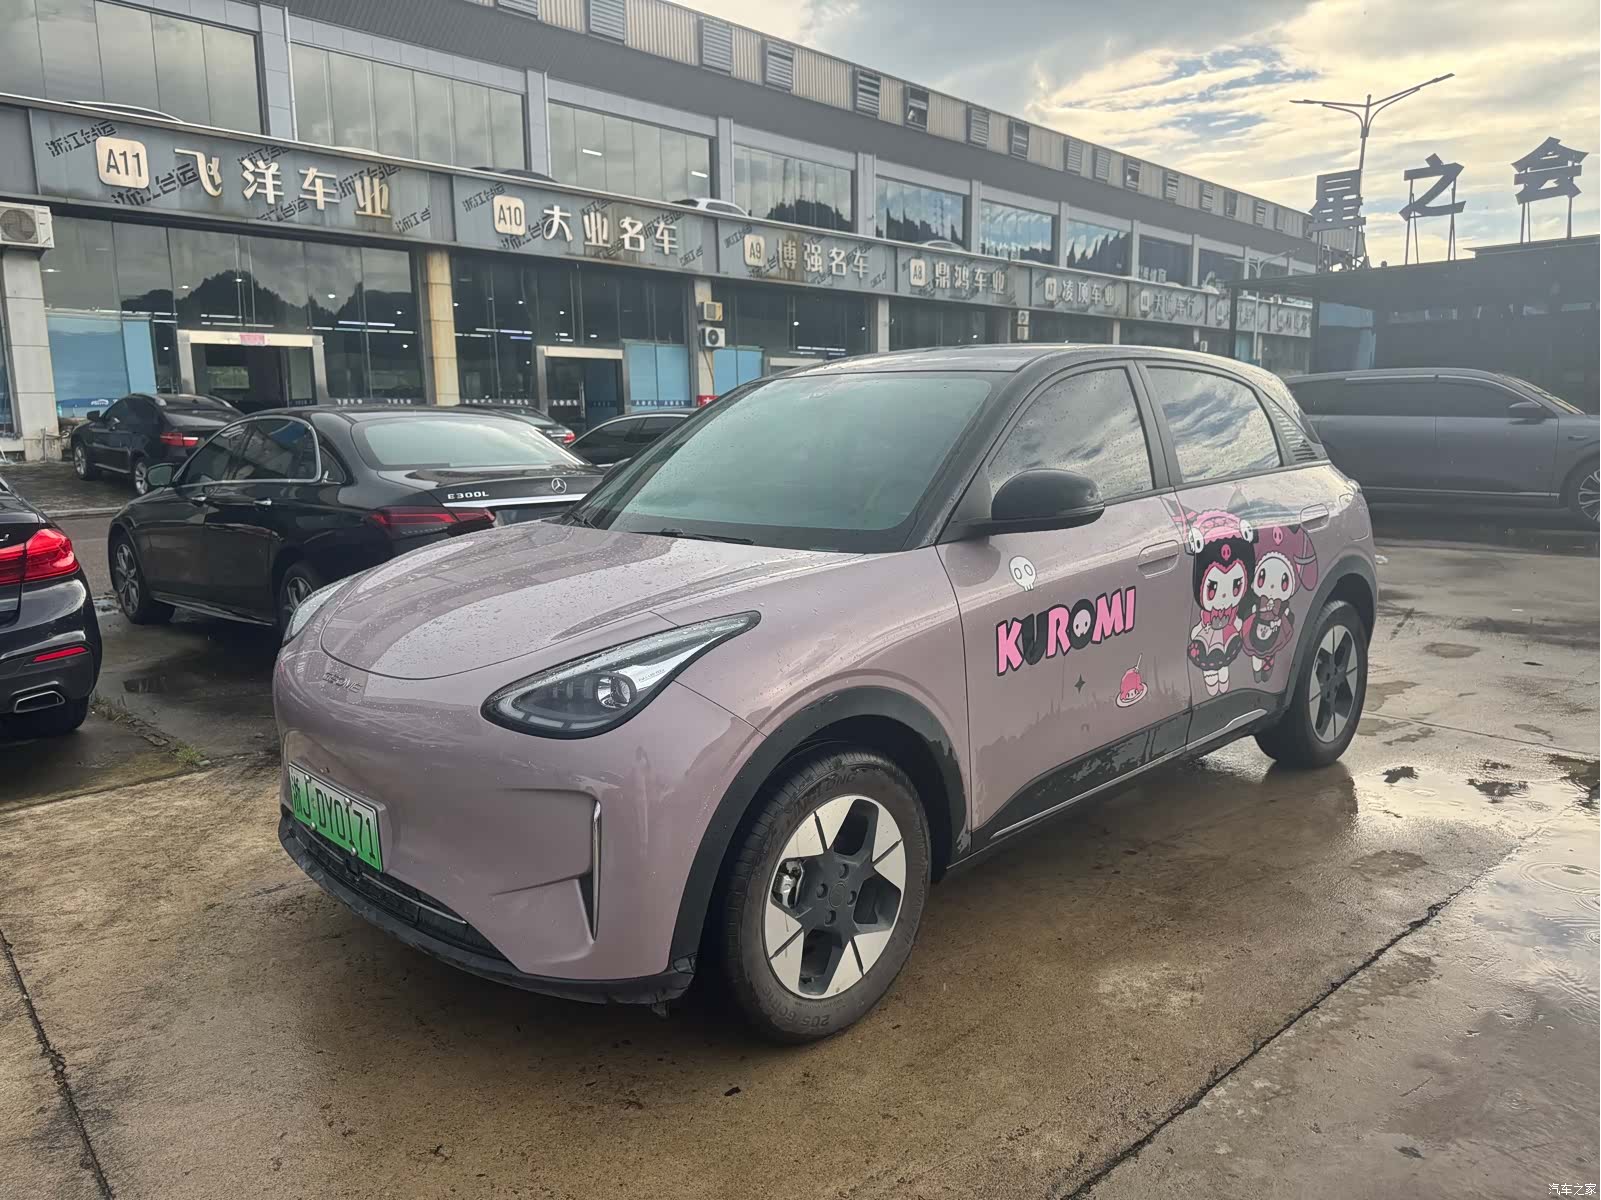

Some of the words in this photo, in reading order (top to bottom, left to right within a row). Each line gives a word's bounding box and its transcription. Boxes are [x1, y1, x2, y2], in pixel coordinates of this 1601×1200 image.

[105, 148, 142, 178] A11
[174, 148, 392, 218] 飞洋车业
[498, 204, 523, 227] A10
[543, 205, 679, 255] 大业名车
[749, 241, 762, 260] A9
[776, 238, 869, 279] 博强名车
[447, 491, 490, 500] E300L
[996, 586, 1136, 676] KUROMI
